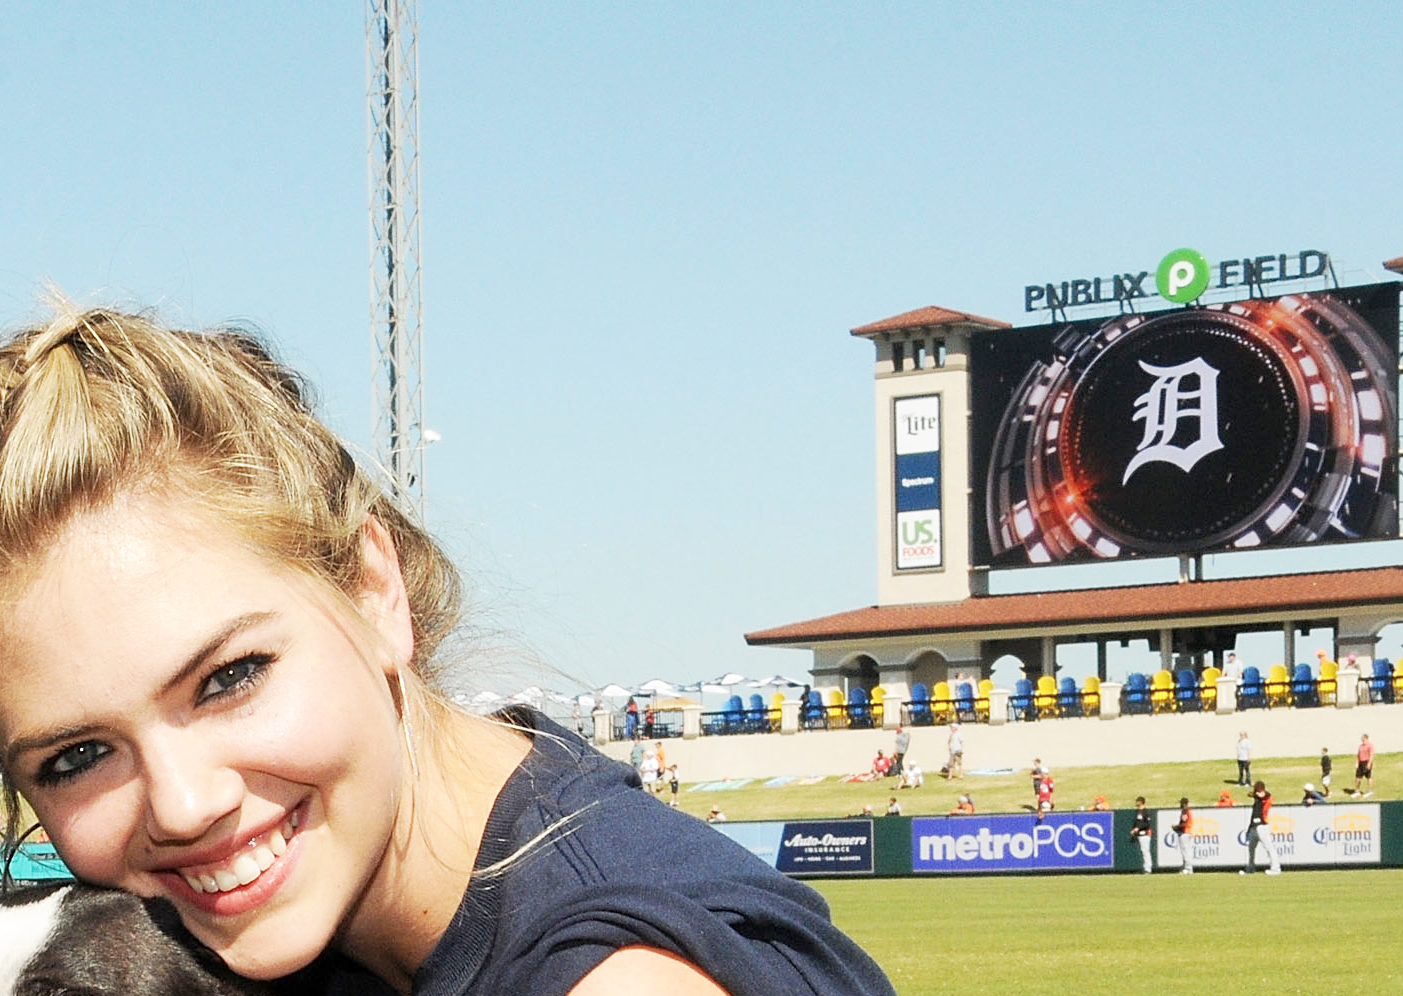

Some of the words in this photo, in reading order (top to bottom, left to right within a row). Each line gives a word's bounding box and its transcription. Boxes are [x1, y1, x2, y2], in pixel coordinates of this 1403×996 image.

[1025, 270, 1148, 312] PUBLIX
[1219, 249, 1327, 289] FIELD
[907, 416, 936, 436] Lite
[902, 545, 935, 557] FOODS
[784, 833, 868, 848] Auto-Owners
[1164, 829, 1220, 849] Cona
[1313, 826, 1372, 846] Corona
[1343, 842, 1372, 856] Light
